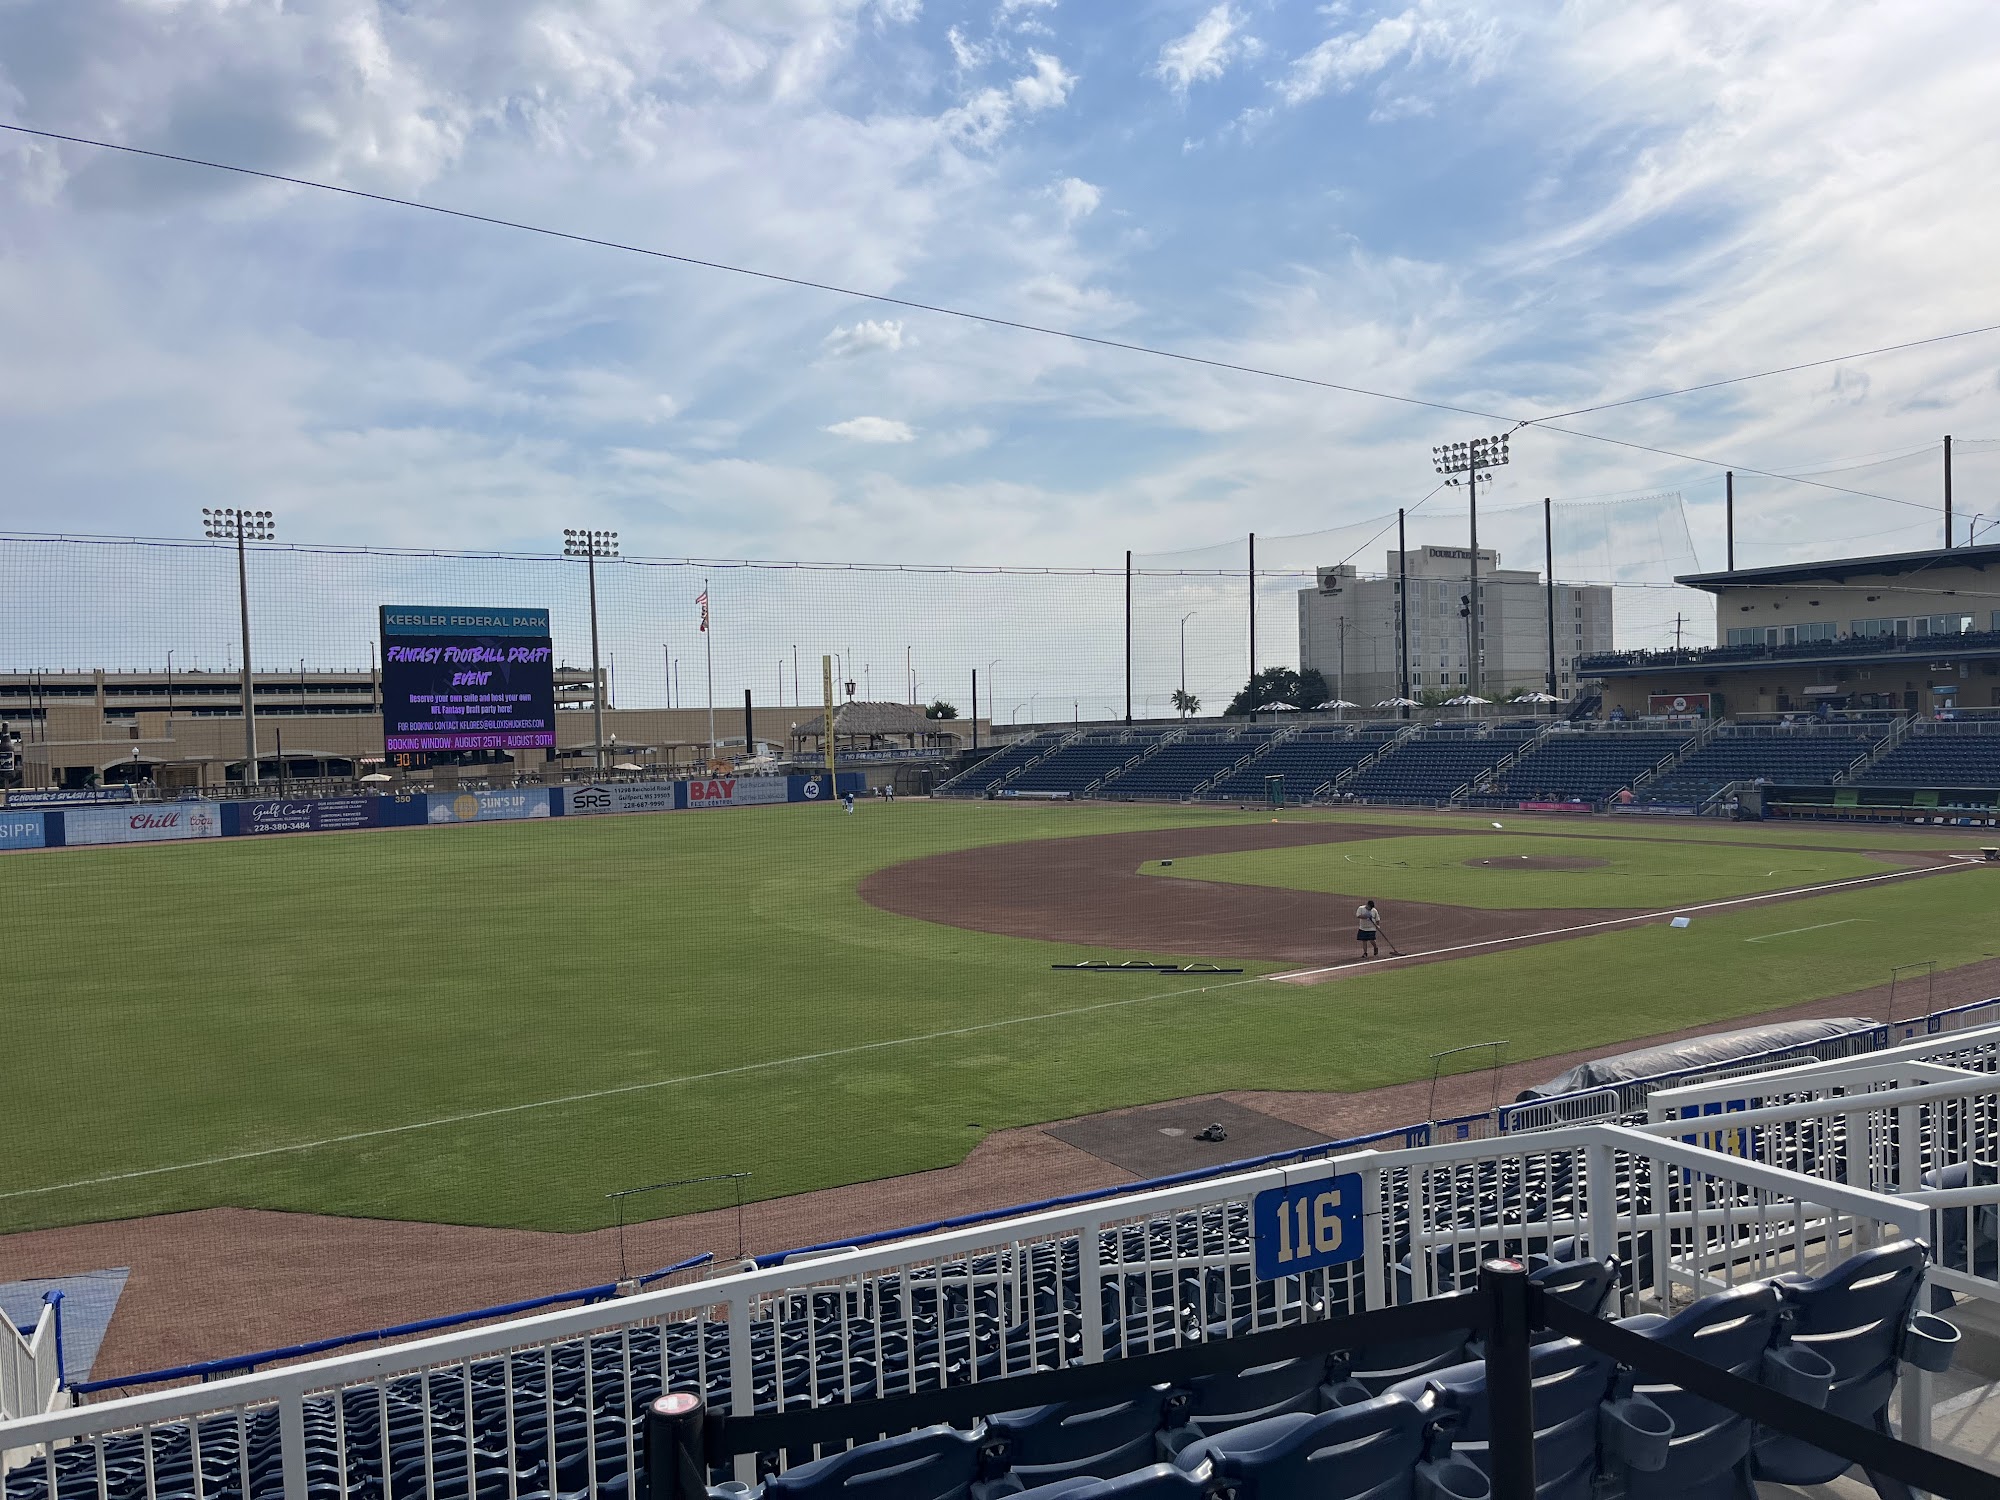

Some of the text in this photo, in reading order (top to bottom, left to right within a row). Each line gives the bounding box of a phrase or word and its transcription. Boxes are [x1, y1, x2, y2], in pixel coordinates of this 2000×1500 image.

[386, 615, 547, 628] KEESLER FEDERAL PARK
[387, 646, 551, 664] FANTASY FOOTBALL DRAFT
[452, 670, 492, 686] EVENT
[435, 694, 448, 704] your
[450, 694, 462, 702] own
[479, 694, 490, 702] and
[490, 693, 504, 702] host
[505, 694, 518, 702] your
[442, 705, 466, 715] Fantasy
[466, 704, 480, 714] Draft
[481, 704, 496, 715] party
[398, 722, 409, 731] FOR
[410, 721, 434, 731] BOOKING
[434, 720, 459, 730] CONTACT
[388, 738, 420, 750] BOOKING
[454, 736, 482, 748] AUGUST
[483, 736, 502, 748] 25TH
[508, 735, 533, 746] AUGUST
[534, 734, 553, 746] 30TH
[690, 780, 736, 800] BAY
[806, 786, 816, 794] 42
[480, 797, 510, 808] SUN'S
[512, 796, 525, 806] UP
[573, 794, 611, 808] SRS
[253, 803, 280, 822] Gulf
[130, 812, 180, 829] Chill
[254, 822, 310, 832] 228-380-3484
[1411, 1131, 1426, 1148] 114
[1277, 1190, 1342, 1264] 116
